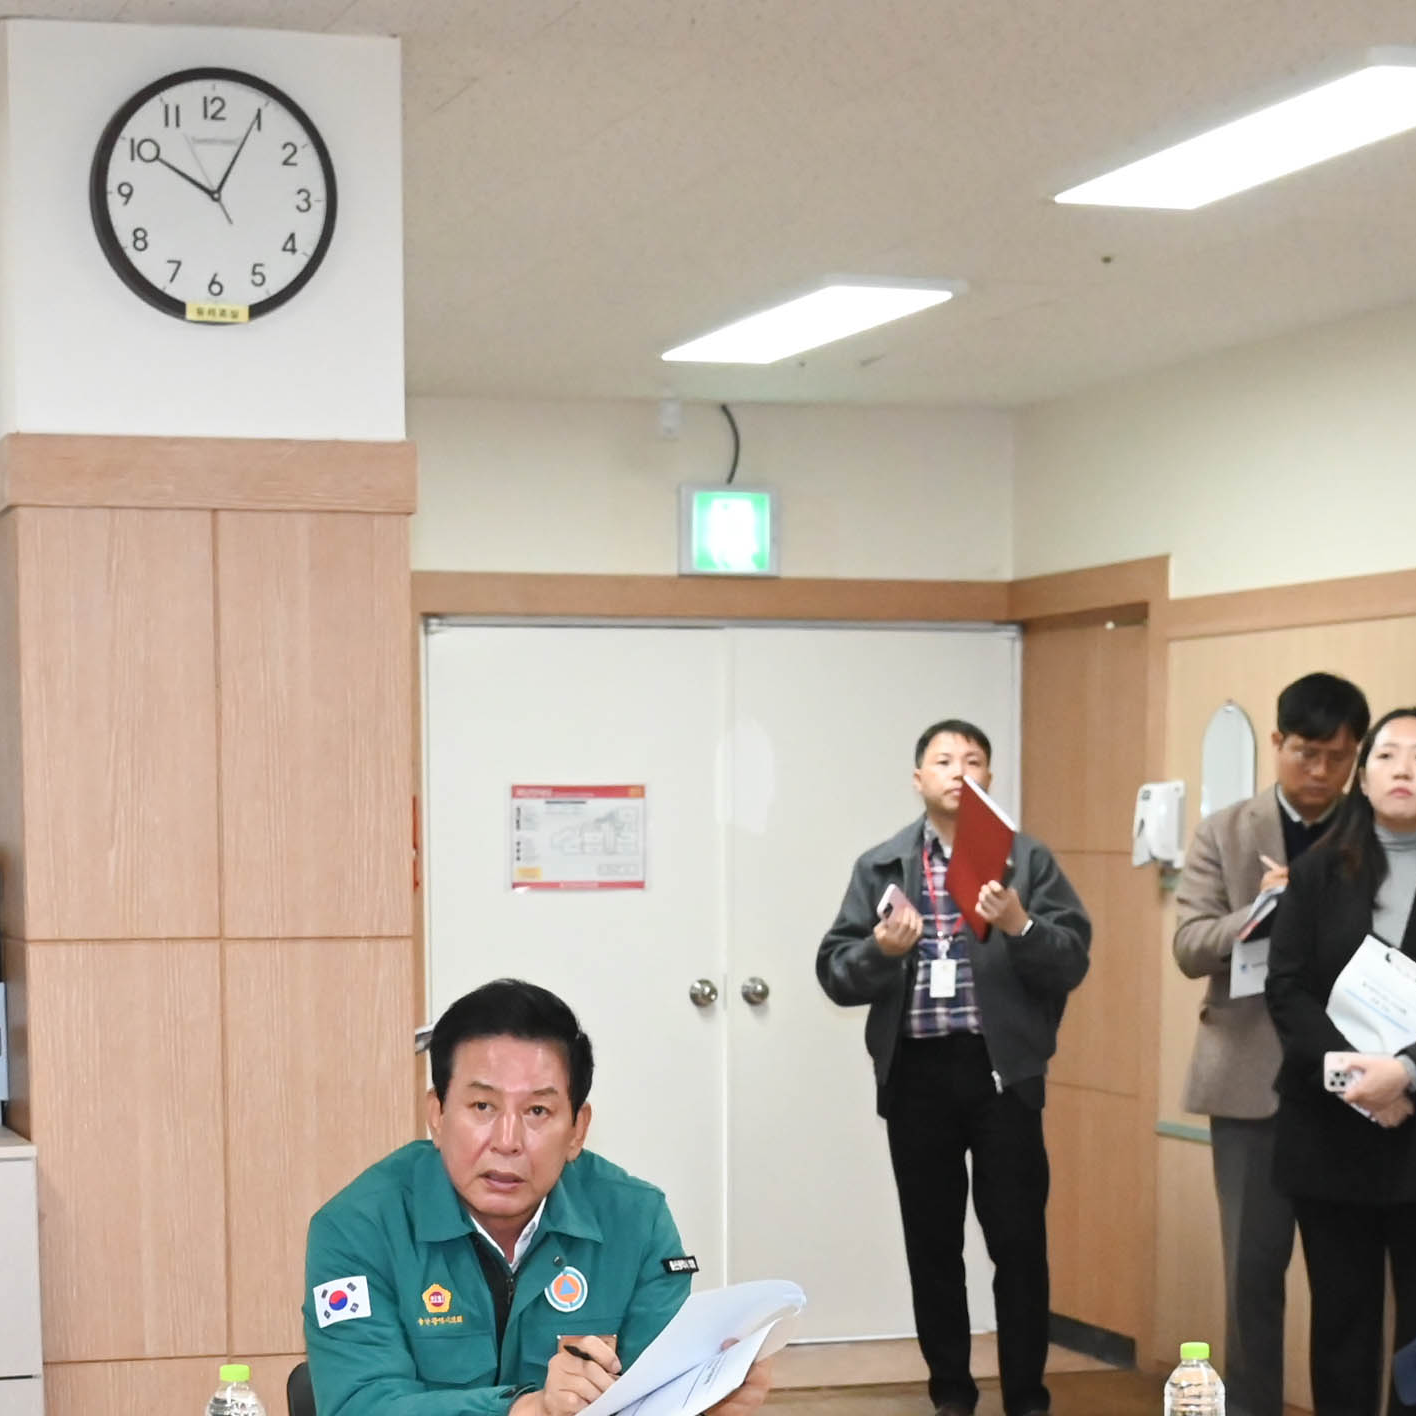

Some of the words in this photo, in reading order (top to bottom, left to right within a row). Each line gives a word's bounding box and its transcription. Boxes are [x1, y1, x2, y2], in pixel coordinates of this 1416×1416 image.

[164, 103, 181, 128] 11
[202, 96, 227, 121] 12
[130, 137, 161, 163] 10
[281, 141, 299, 166] 2
[117, 181, 134, 206] 9
[294, 188, 312, 213] 3
[132, 227, 149, 252] 8
[281, 231, 298, 256] 4
[166, 259, 182, 283] 7
[250, 262, 266, 287] 5
[207, 272, 224, 297] 6
